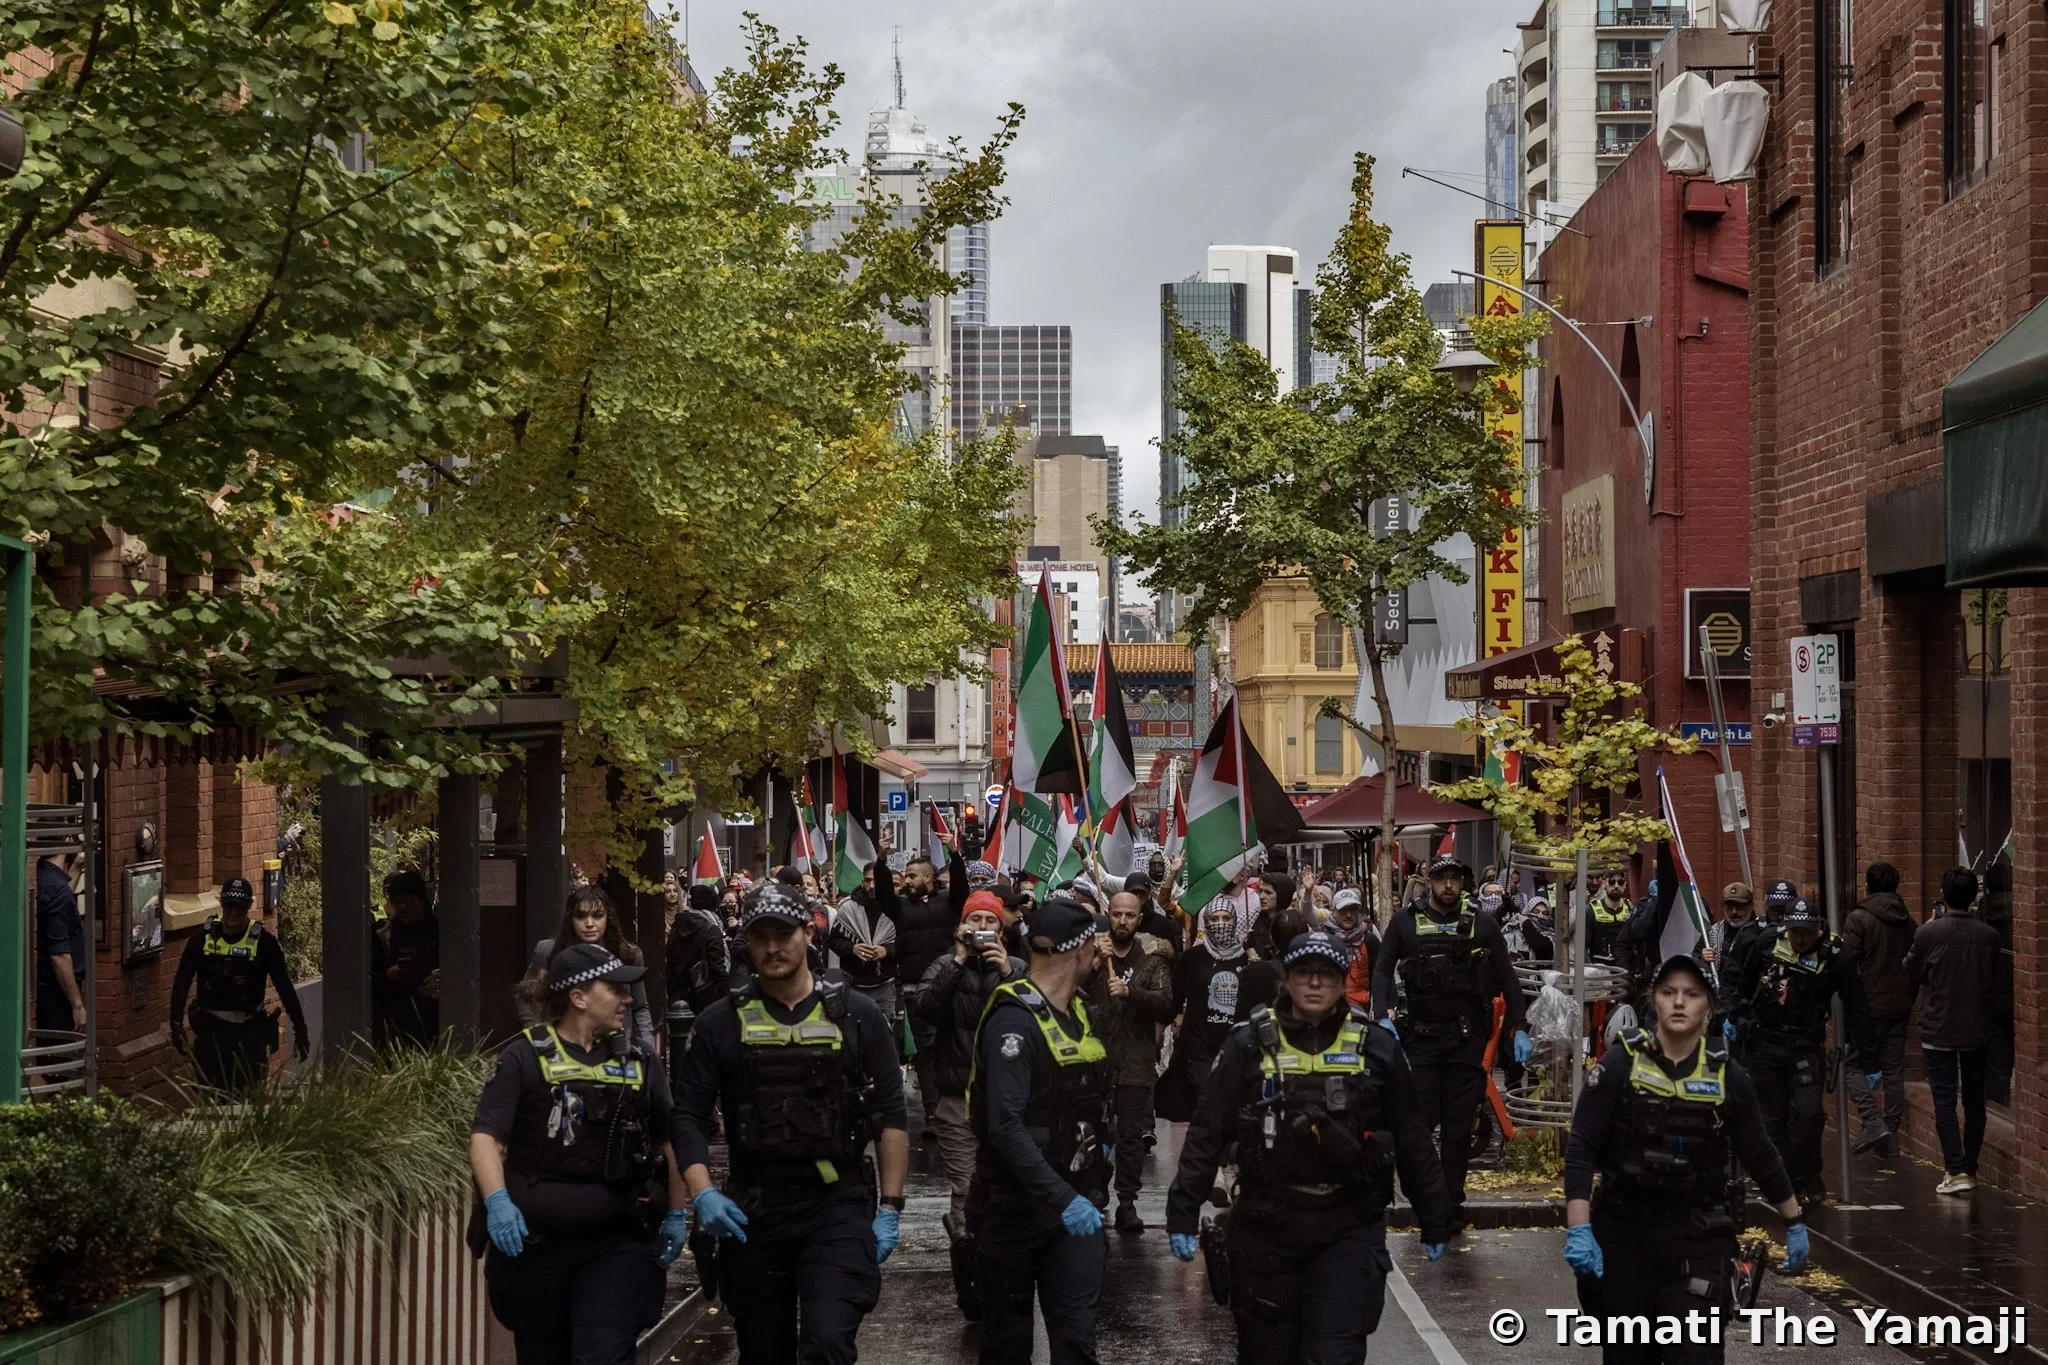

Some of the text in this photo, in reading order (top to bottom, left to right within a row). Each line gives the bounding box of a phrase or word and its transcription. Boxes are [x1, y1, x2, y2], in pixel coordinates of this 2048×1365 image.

[1027, 563, 1067, 572] WELOME
[1070, 563, 1096, 572] HOTEL
[1816, 644, 1836, 665] 2P
[1738, 728, 1752, 740] La
[1819, 727, 1837, 738] 7538
[892, 794, 902, 809] P
